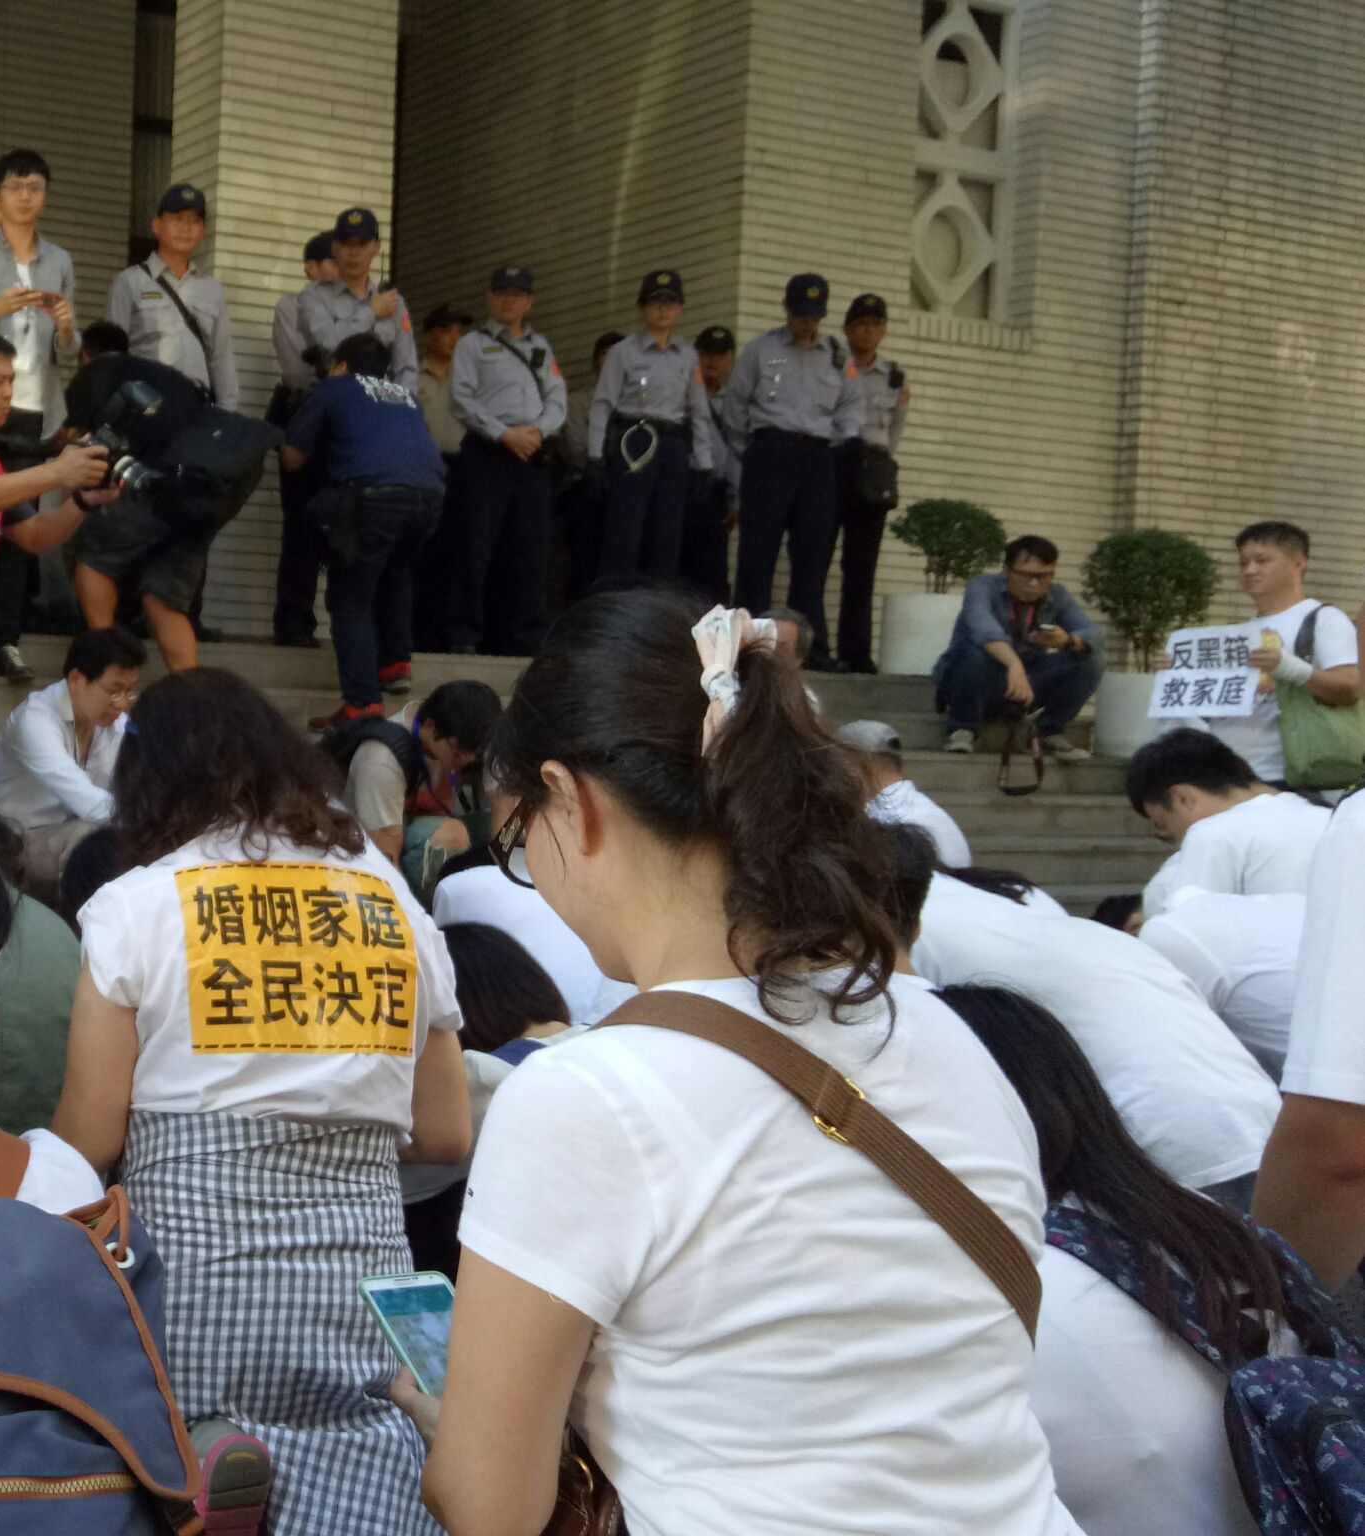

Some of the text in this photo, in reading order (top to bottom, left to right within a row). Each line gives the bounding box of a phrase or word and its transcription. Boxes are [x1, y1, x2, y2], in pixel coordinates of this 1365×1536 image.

[1171, 636, 1250, 670] 反黑箱
[1160, 674, 1248, 708] 救家庭
[193, 884, 407, 950] 婚姻家庭
[202, 958, 410, 1029] 全民決定
